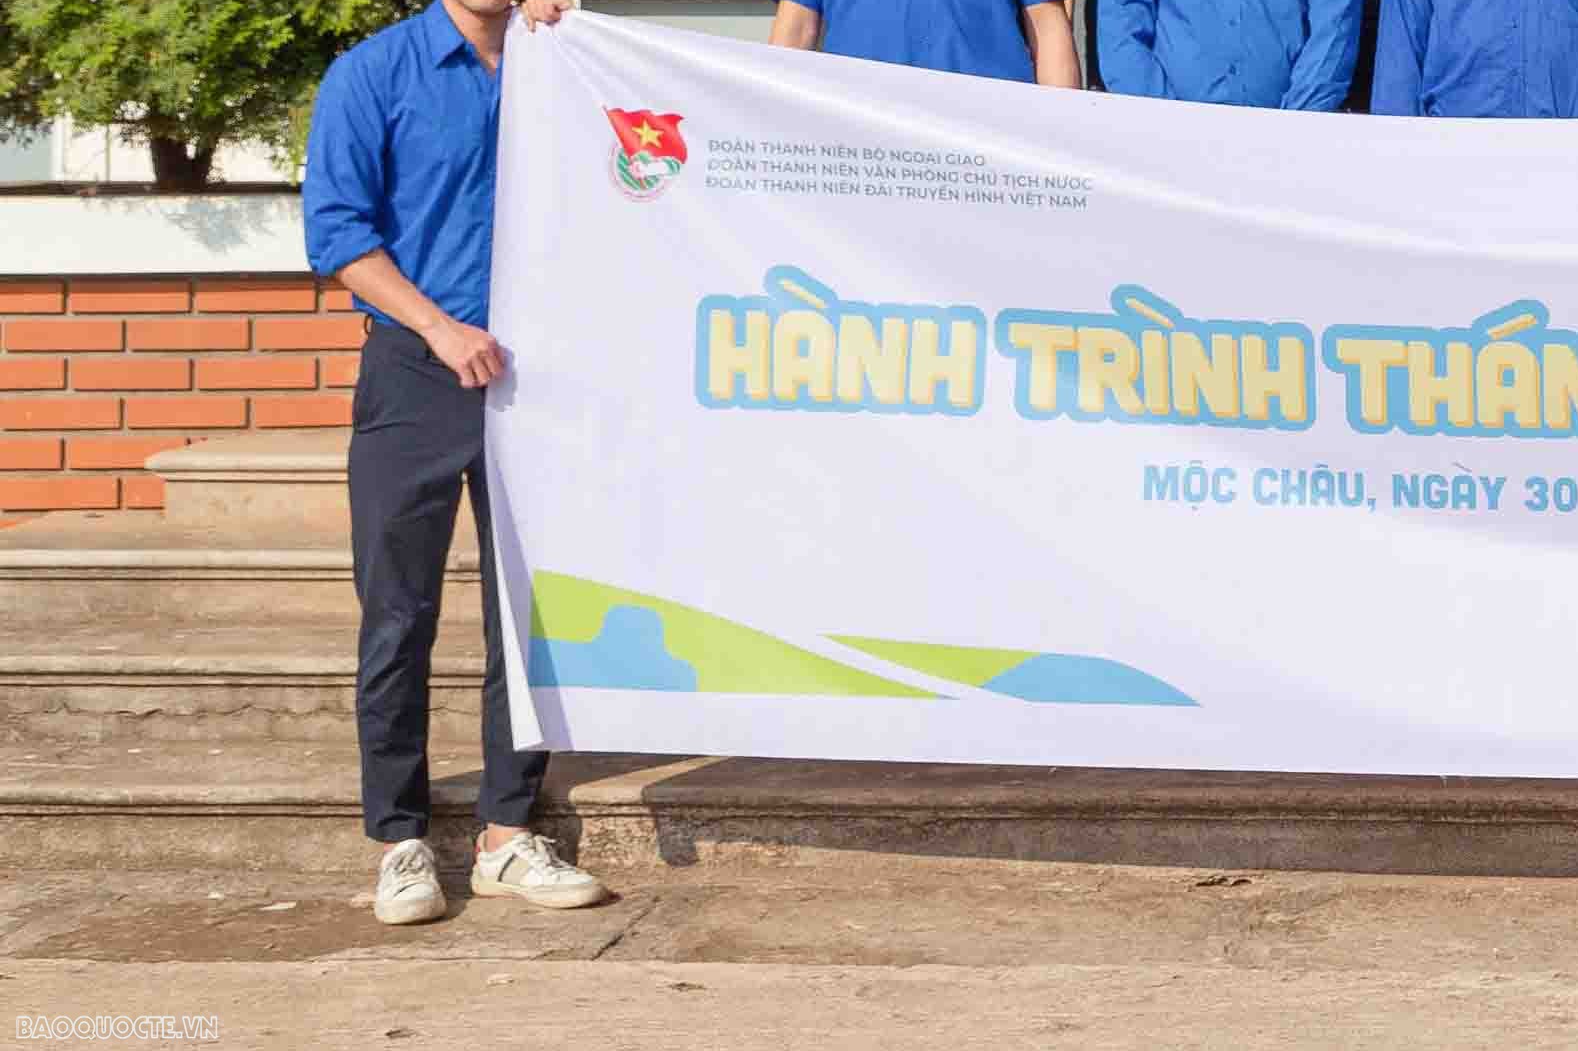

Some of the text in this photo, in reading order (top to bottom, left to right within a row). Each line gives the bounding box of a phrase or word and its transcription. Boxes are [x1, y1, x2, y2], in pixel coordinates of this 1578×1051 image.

[760, 141, 817, 157] THANH
[821, 141, 857, 160] NIÊN
[863, 145, 886, 163] BỘ
[945, 152, 985, 167] GIAO
[760, 160, 817, 176] THANH
[821, 161, 859, 177] NIÊN
[1002, 174, 1039, 190] TỊCH
[760, 179, 817, 195] THANH
[822, 178, 860, 196] NIÊN
[1008, 192, 1044, 209] VIỆT
[1050, 194, 1088, 210] NAM
[697, 266, 985, 416] HÀNH
[997, 286, 1315, 430] TRÌNH
[1142, 459, 1237, 512] MỘC
[1253, 462, 1377, 512] CHÂU,
[1392, 461, 1506, 511] NGÀY
